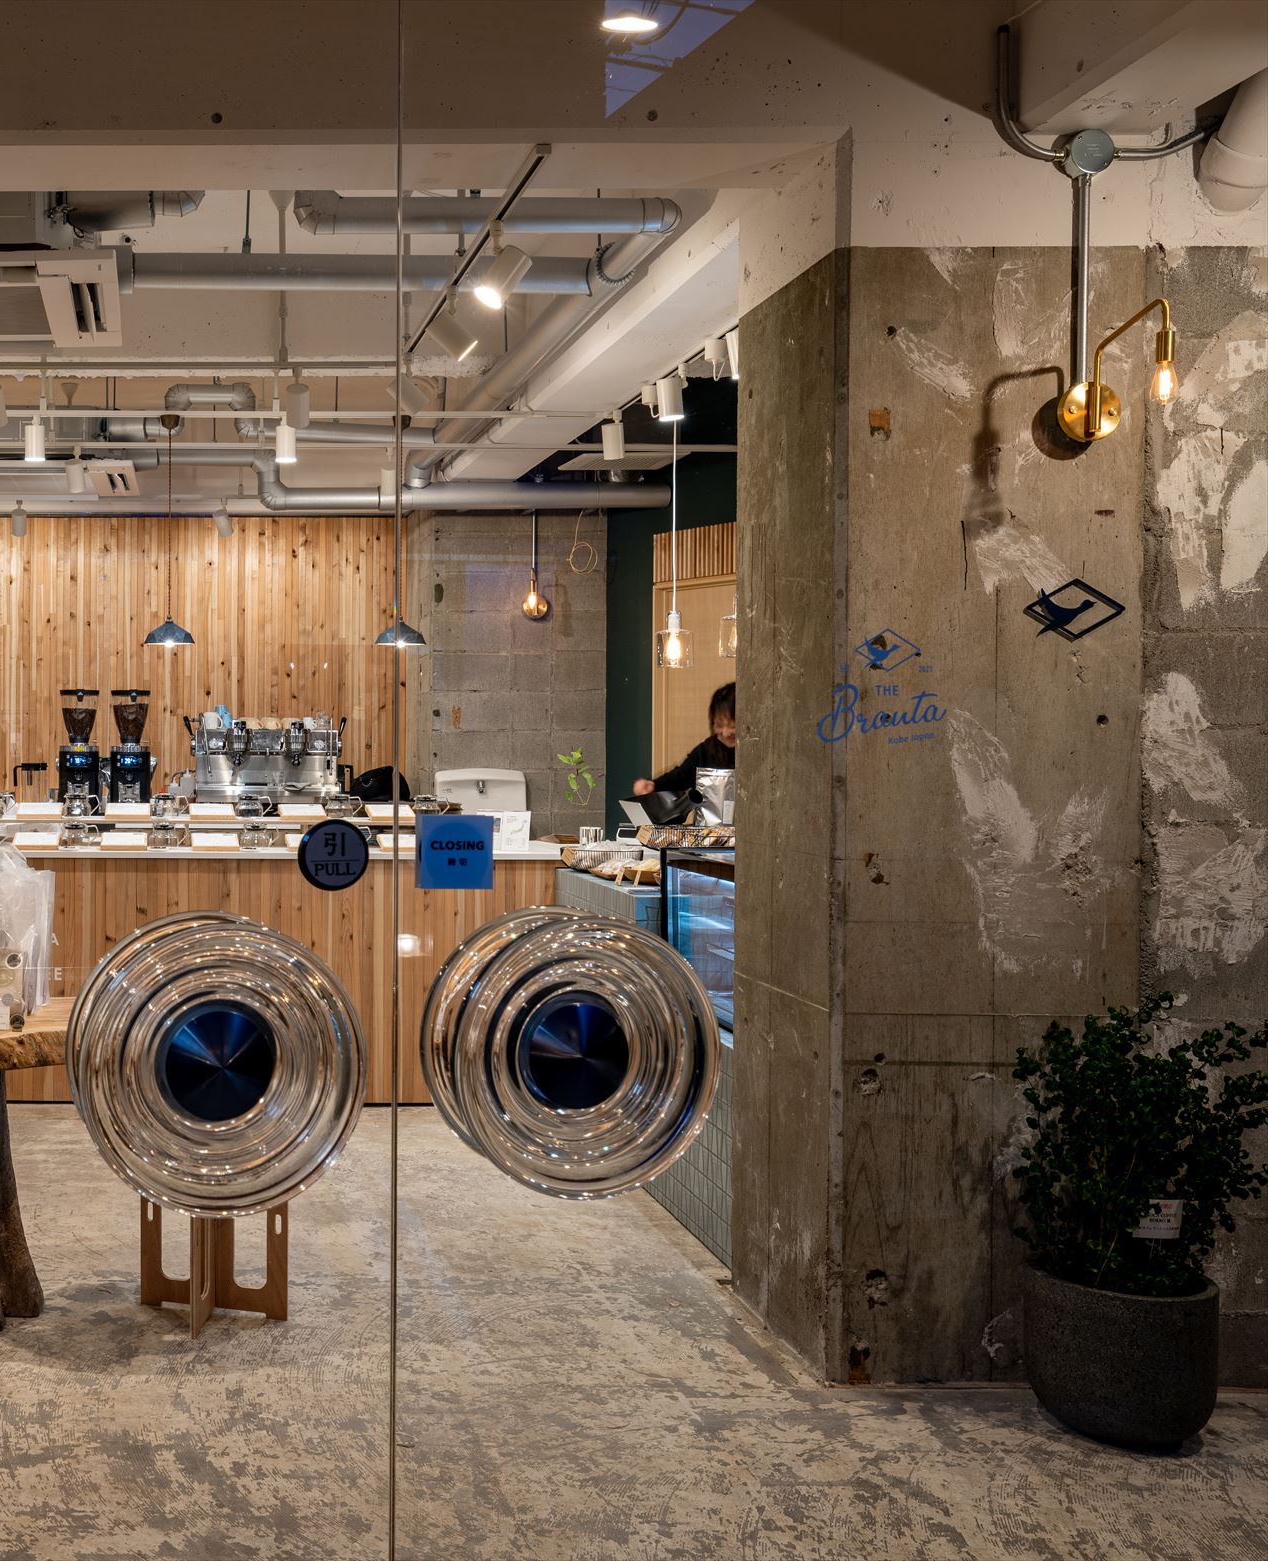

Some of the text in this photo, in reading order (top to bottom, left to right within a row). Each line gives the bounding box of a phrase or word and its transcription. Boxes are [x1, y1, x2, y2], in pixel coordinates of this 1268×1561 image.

[875, 685, 899, 696] THE
[323, 832, 346, 857] 引
[430, 840, 485, 851] CLOSING
[314, 862, 356, 877] PULL
